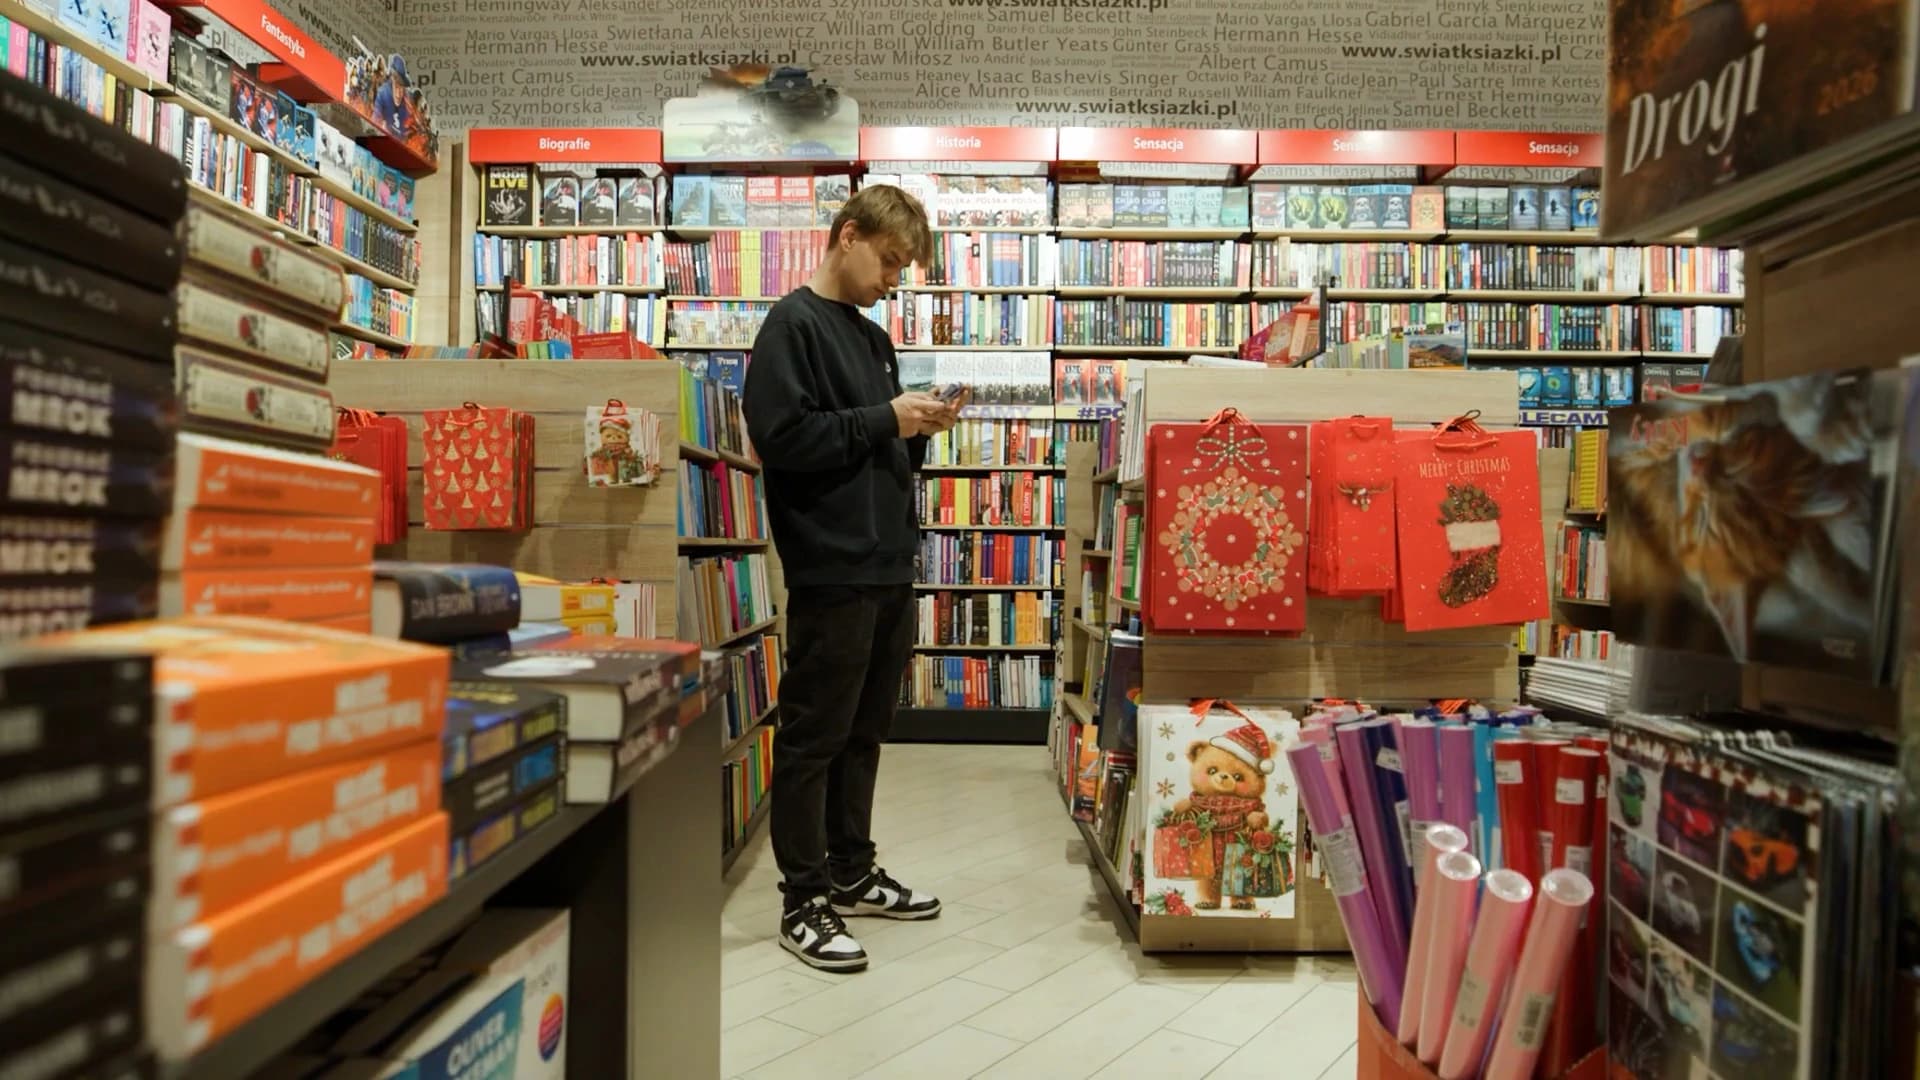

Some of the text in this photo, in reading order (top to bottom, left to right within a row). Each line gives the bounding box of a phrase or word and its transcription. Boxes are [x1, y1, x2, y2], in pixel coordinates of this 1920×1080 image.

[681, 11, 733, 25] Henryk
[987, 7, 1055, 23] Samuel
[1064, 8, 1131, 23] Beckett
[1216, 12, 1258, 25] Mario
[1265, 13, 1316, 28] Vargas
[1322, 13, 1361, 27] Llosa
[1365, 10, 1430, 27] Gabriel
[260, 13, 306, 60] Fantastyka
[466, 29, 505, 41] Mario
[510, 29, 556, 42] Vargas
[563, 28, 598, 40] Llosa
[826, 19, 975, 39] William Golding
[1112, 27, 1208, 39] John Steinbeck
[1214, 27, 1363, 43] Hermann Hesse
[465, 39, 608, 54] Hermann Hesse
[789, 39, 865, 51] Heinrich
[914, 36, 1108, 52] William Butler Yeats
[1175, 39, 1220, 53] Grass
[580, 50, 797, 68] www.swiatksiazki.pl
[808, 50, 952, 66] Czesław Miłosz
[1341, 43, 1561, 64] www.swiatksiazki.pl
[416, 56, 459, 69] Grass
[1199, 54, 1256, 70] Albert
[1264, 55, 1328, 71] Camus
[450, 70, 503, 85] Albert
[512, 68, 573, 85] Camus
[854, 69, 970, 83] Seamus Heaney
[977, 69, 1179, 88] Isaac Bashevis Singer
[1186, 70, 1267, 83] Octavio Paz
[1325, 72, 1360, 86] Gide
[1452, 74, 1505, 88] Sartre
[1512, 75, 1546, 88] Imre
[438, 87, 515, 98] Octavio Paz
[915, 83, 961, 98] Alice
[969, 83, 1029, 99] Munro
[1110, 86, 1231, 98] Bertrand Russell
[1235, 85, 1291, 99] William
[1296, 86, 1362, 99] Faulkner
[1425, 88, 1482, 102] Ernest
[1491, 89, 1601, 106] Hemingway
[1621, 21, 1768, 177] Drogi
[429, 99, 484, 116] isława
[491, 99, 603, 119] Szymborska
[1015, 99, 1237, 120] www.swiatksiazki.pl
[1393, 101, 1460, 118] Samuel
[1468, 102, 1536, 119] Beckett
[539, 137, 591, 151] Biografie
[935, 136, 982, 149] Historia
[1133, 137, 1185, 151] Sensacja
[1528, 141, 1580, 155] Sensacja
[490, 178, 528, 189] LIVE
[1522, 411, 1608, 424] LECAM
[1419, 456, 1511, 479] MERRY CHRISTMAS
